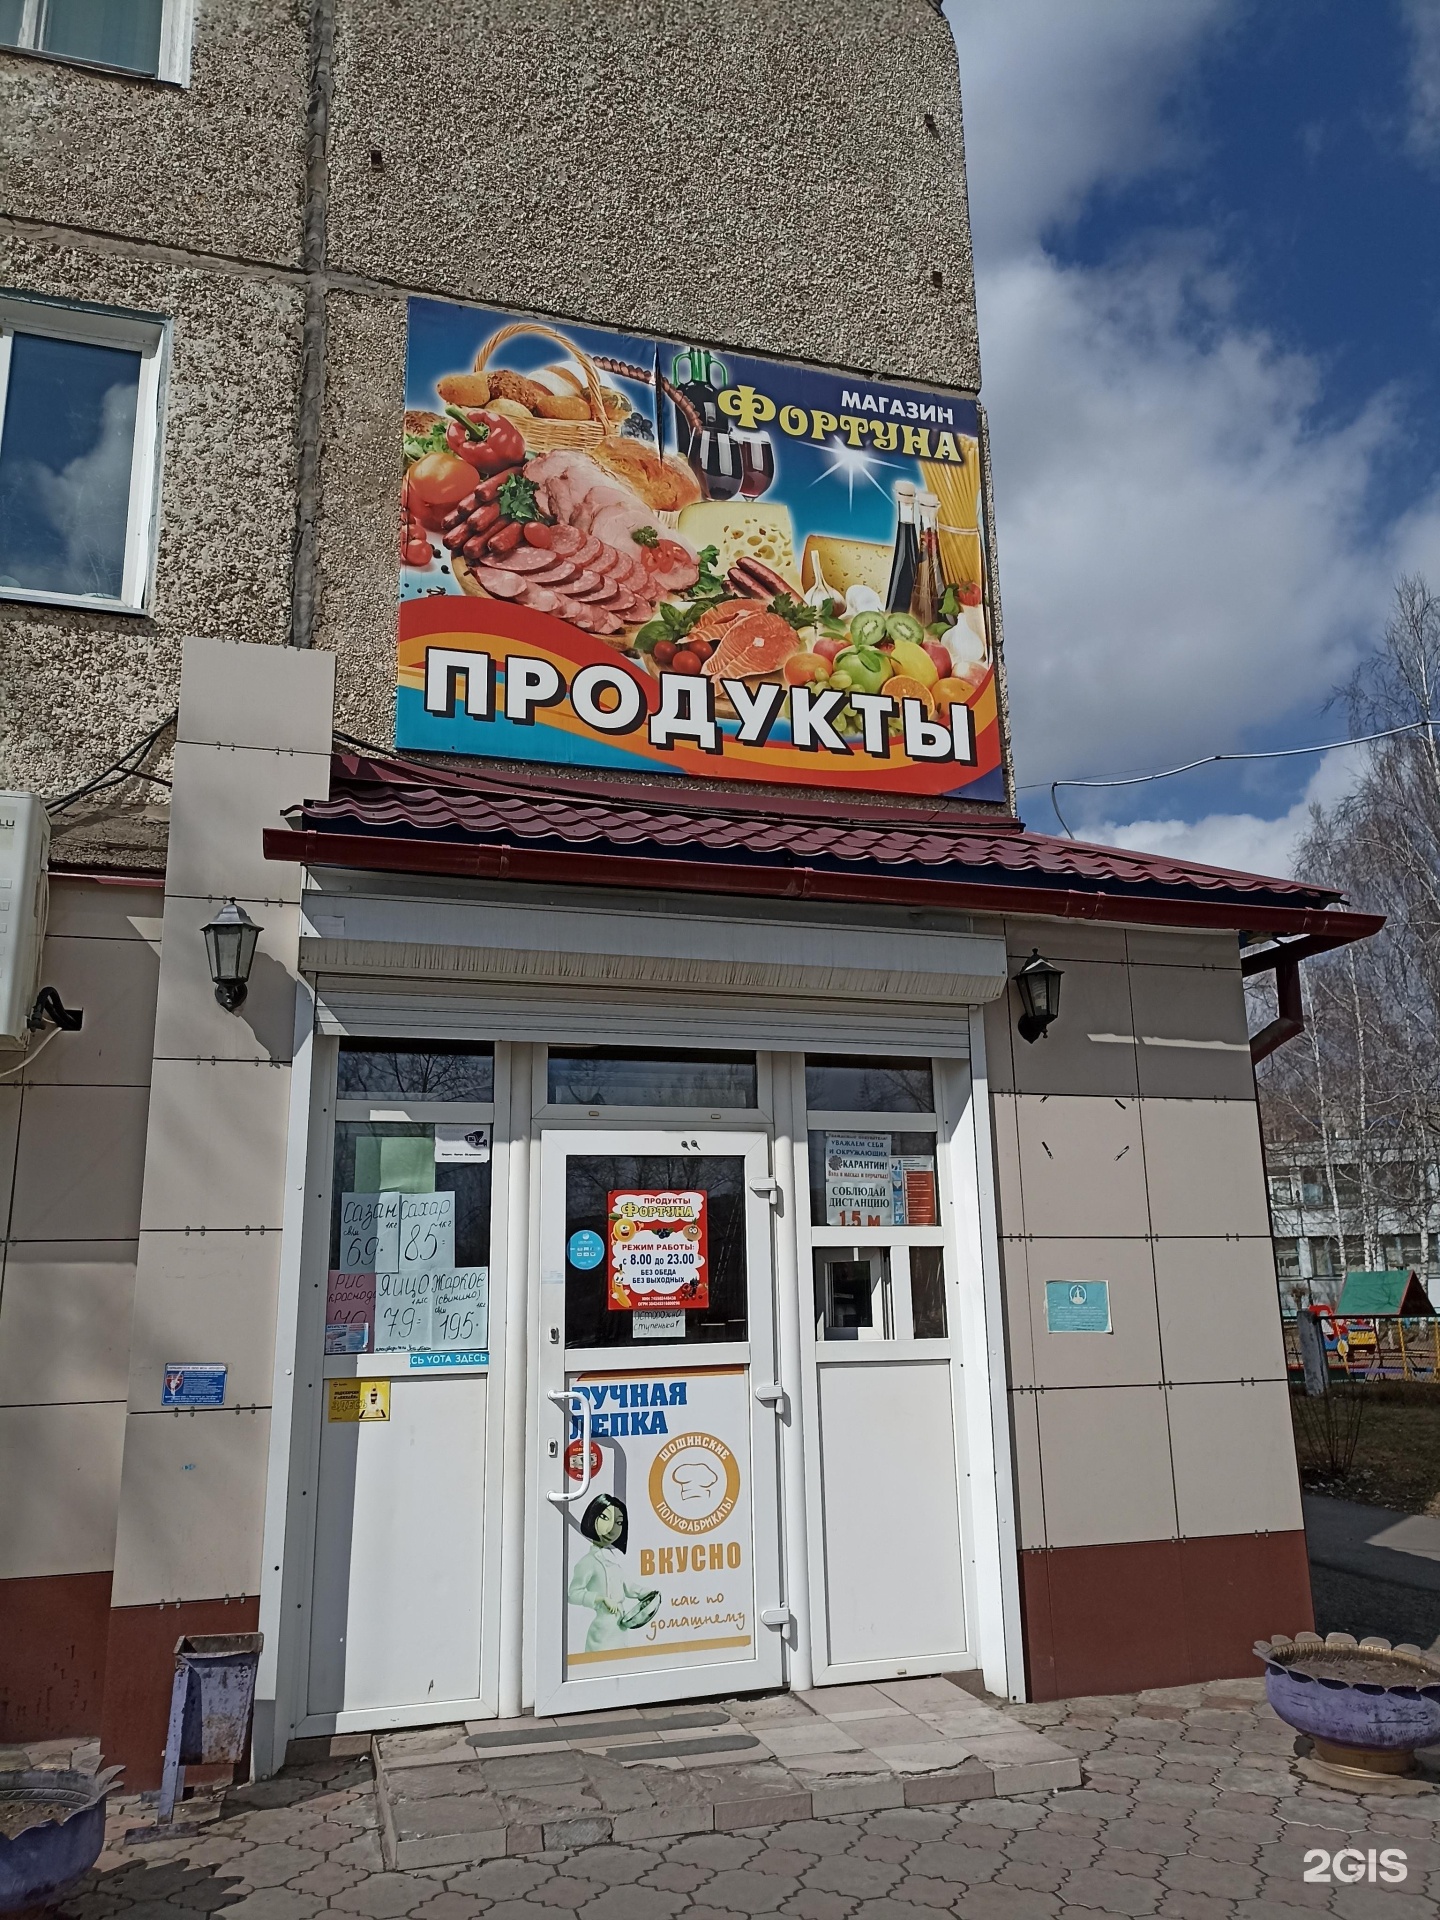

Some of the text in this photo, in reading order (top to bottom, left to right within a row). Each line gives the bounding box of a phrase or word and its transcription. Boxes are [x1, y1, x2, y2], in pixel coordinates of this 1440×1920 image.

[841, 390, 955, 426] МАГАЗИН
[424, 646, 976, 764] ПРОДУКТЫ
[842, 1159, 888, 1170] КАРАНТИН!
[832, 1185, 886, 1197] СОБЛЮДАЙ
[400, 1199, 451, 1221] Сахар
[644, 1197, 691, 1205] ПРОДУКТЫ
[828, 1197, 890, 1209] ДИСТАНЦИЮ
[343, 1201, 398, 1230] Сазан
[656, 1243, 695, 1251] РАБОТЫ:
[630, 1253, 652, 1265] 8.00
[654, 1256, 665, 1266] до
[667, 1253, 695, 1265] 23.00
[646, 1276, 685, 1284] ВЫХОДНЫХ
[654, 1268, 677, 1276] ОБЕДА
[455, 1353, 487, 1363] ЗДЕСЬ
[571, 1381, 688, 1411] РУЧНАЯ
[569, 1410, 669, 1440] ЛЕПКА
[658, 1435, 731, 1462] ШОШИНСКИЕ
[656, 1496, 734, 1533] ПОЛУФАБРИКАТЫ
[640, 1541, 742, 1577] ВКУСНО
[670, 1592, 725, 1608] как по
[646, 1611, 746, 1641] домашнему
